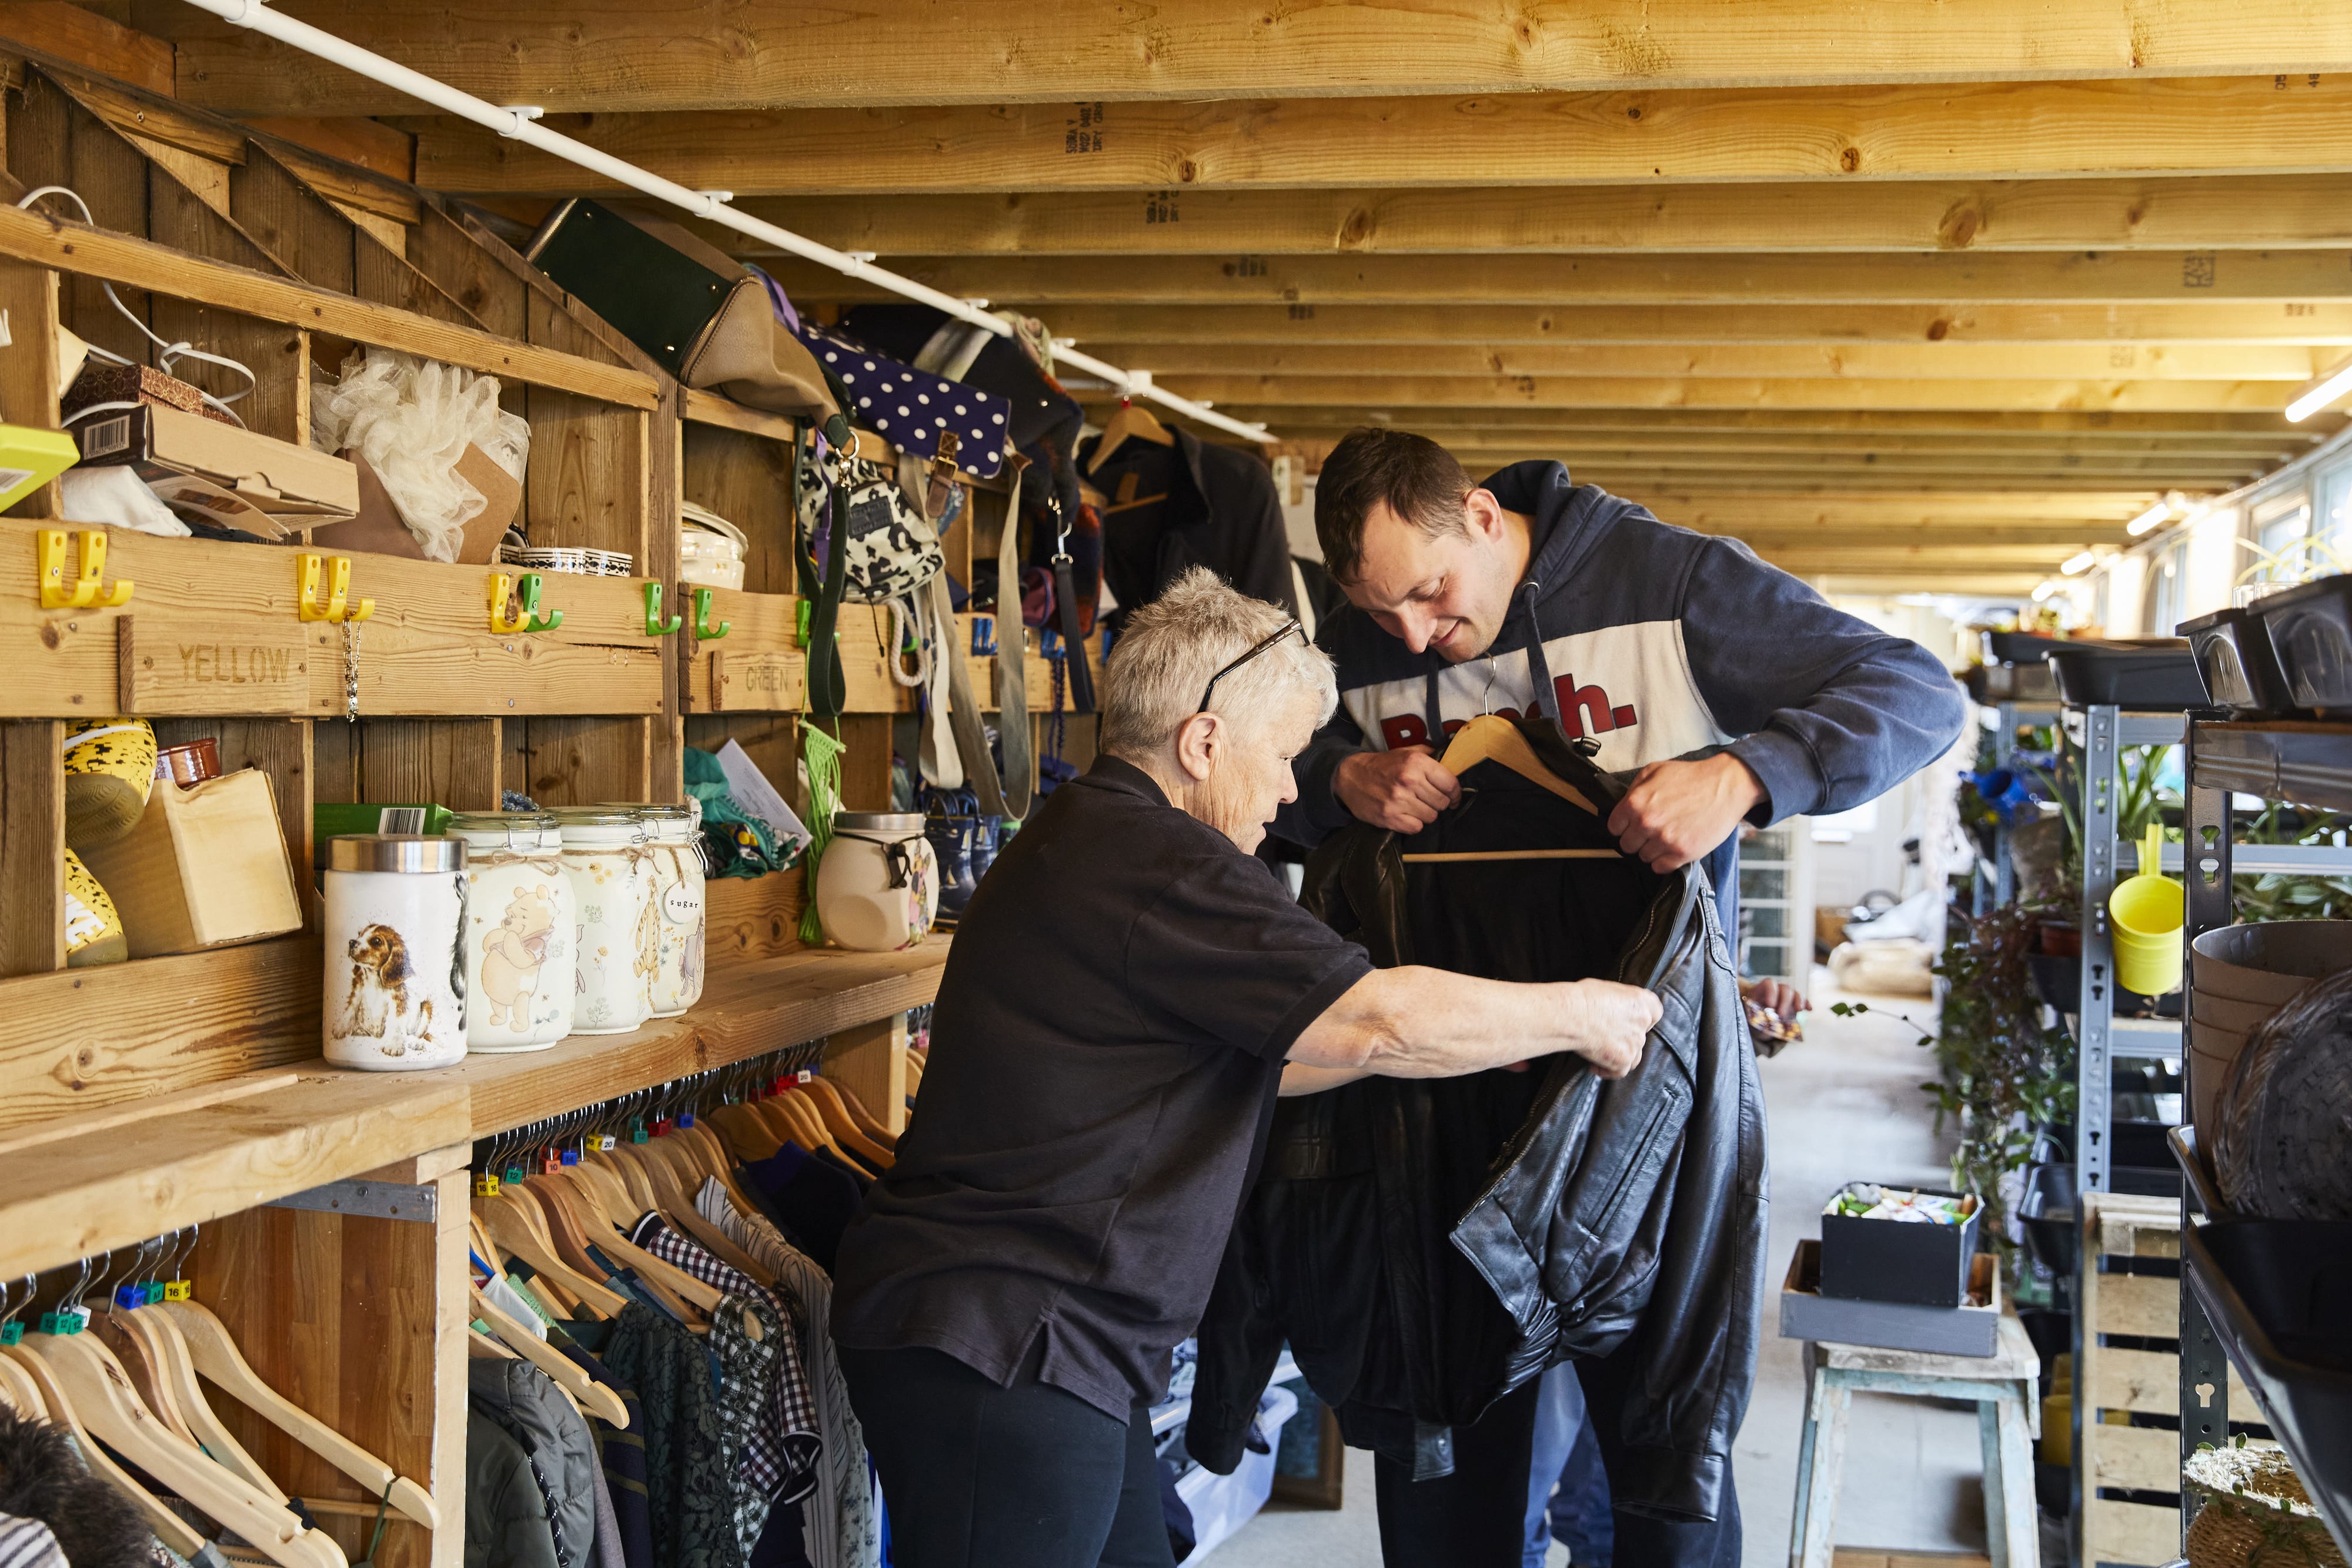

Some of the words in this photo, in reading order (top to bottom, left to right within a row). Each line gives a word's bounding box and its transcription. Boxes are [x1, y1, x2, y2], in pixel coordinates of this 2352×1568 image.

[178, 644, 290, 683] YELLOW
[746, 666, 789, 692] GREEN
[670, 900, 698, 908] sugar
[509, 1172, 519, 1180] 12
[168, 1288, 179, 1297] 16
[61, 1319, 68, 1329] 12
[74, 1320, 82, 1330] 12
